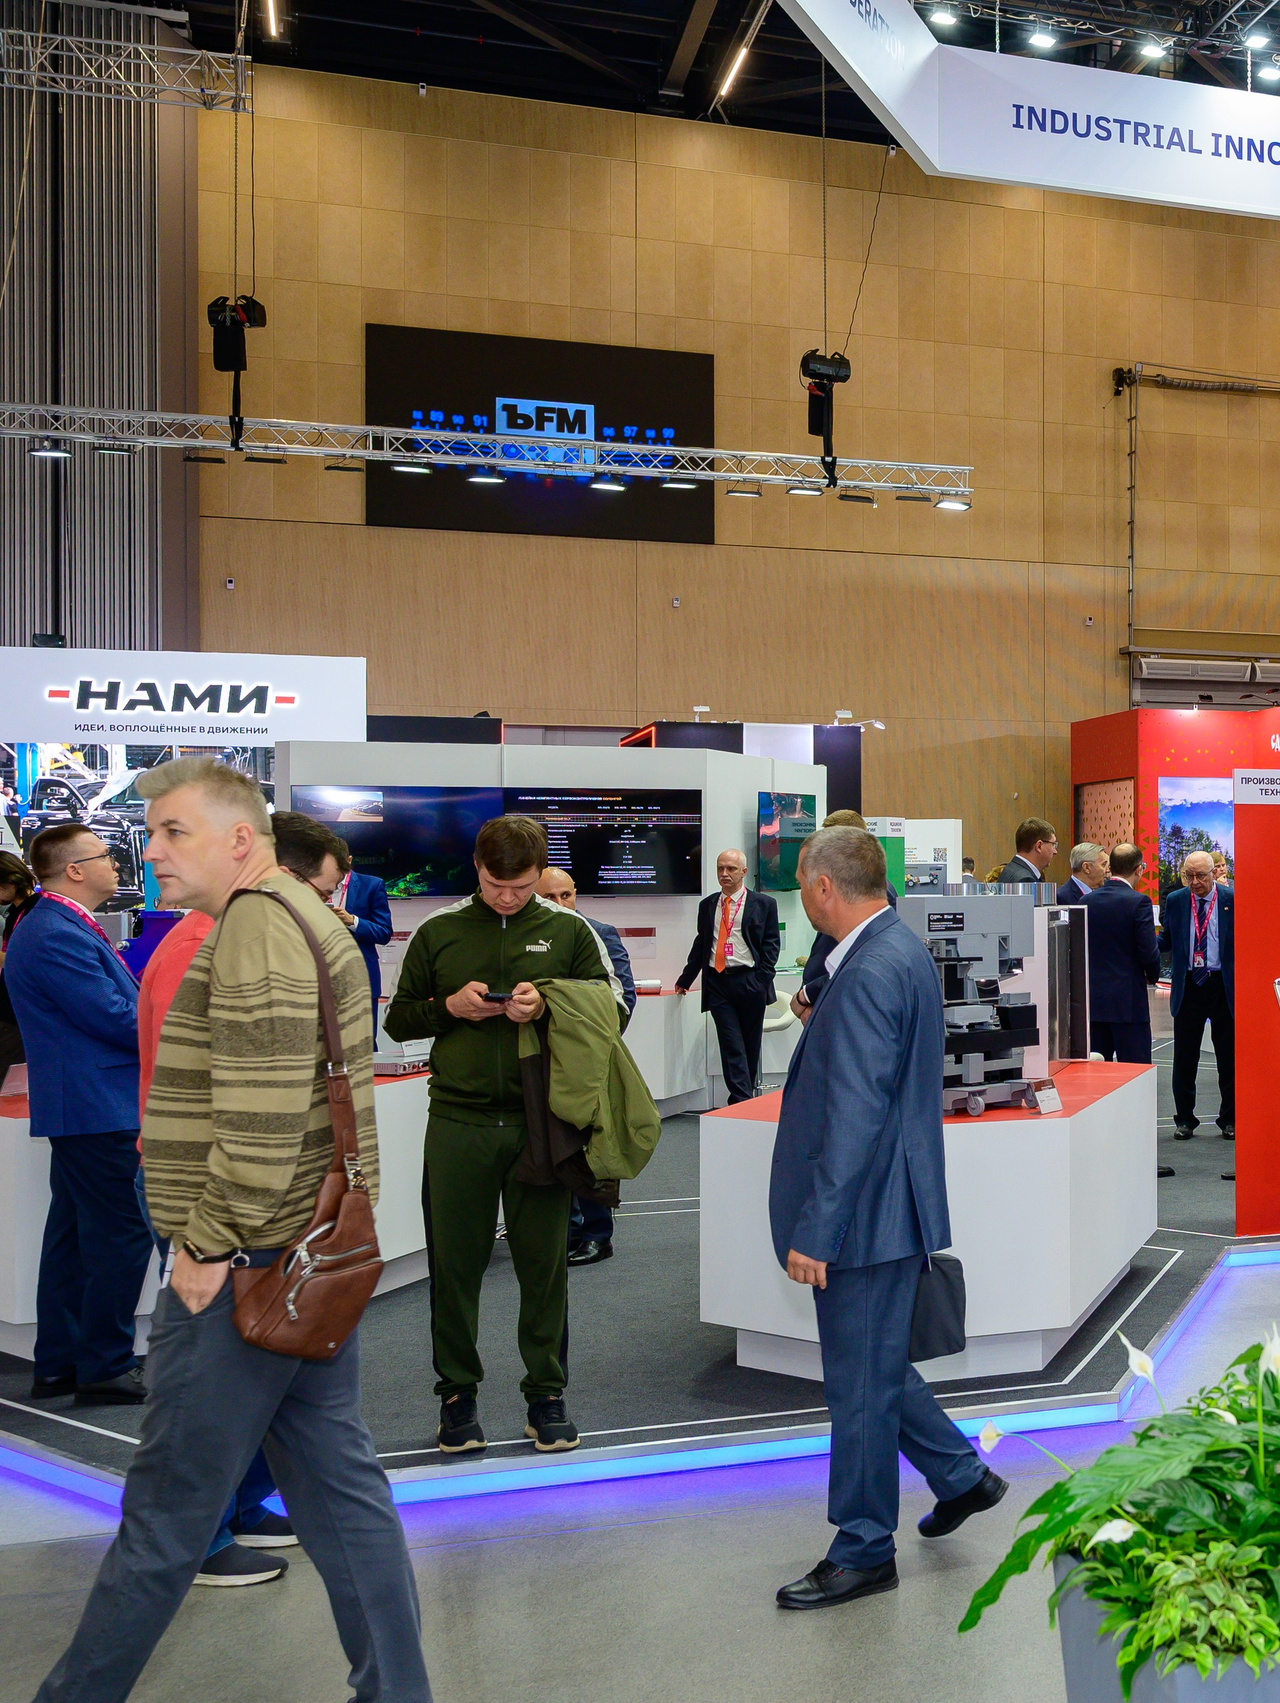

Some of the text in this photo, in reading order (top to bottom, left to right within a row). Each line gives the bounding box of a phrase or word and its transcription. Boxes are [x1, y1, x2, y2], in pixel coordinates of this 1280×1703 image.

[849, 0, 906, 66] ERATION
[1012, 103, 1203, 155] INDUSTRIAL
[473, 415, 488, 427] 91
[623, 426, 638, 438] 97
[501, 403, 587, 435] ЪFM
[75, 679, 269, 714] НАМИ
[74, 723, 107, 732] ИДЕИ,
[109, 722, 196, 734] ВОПЛОЩЁННЫЕ
[207, 726, 268, 735] ДВИЖЕНИИ
[525, 944, 548, 952] PUMA
